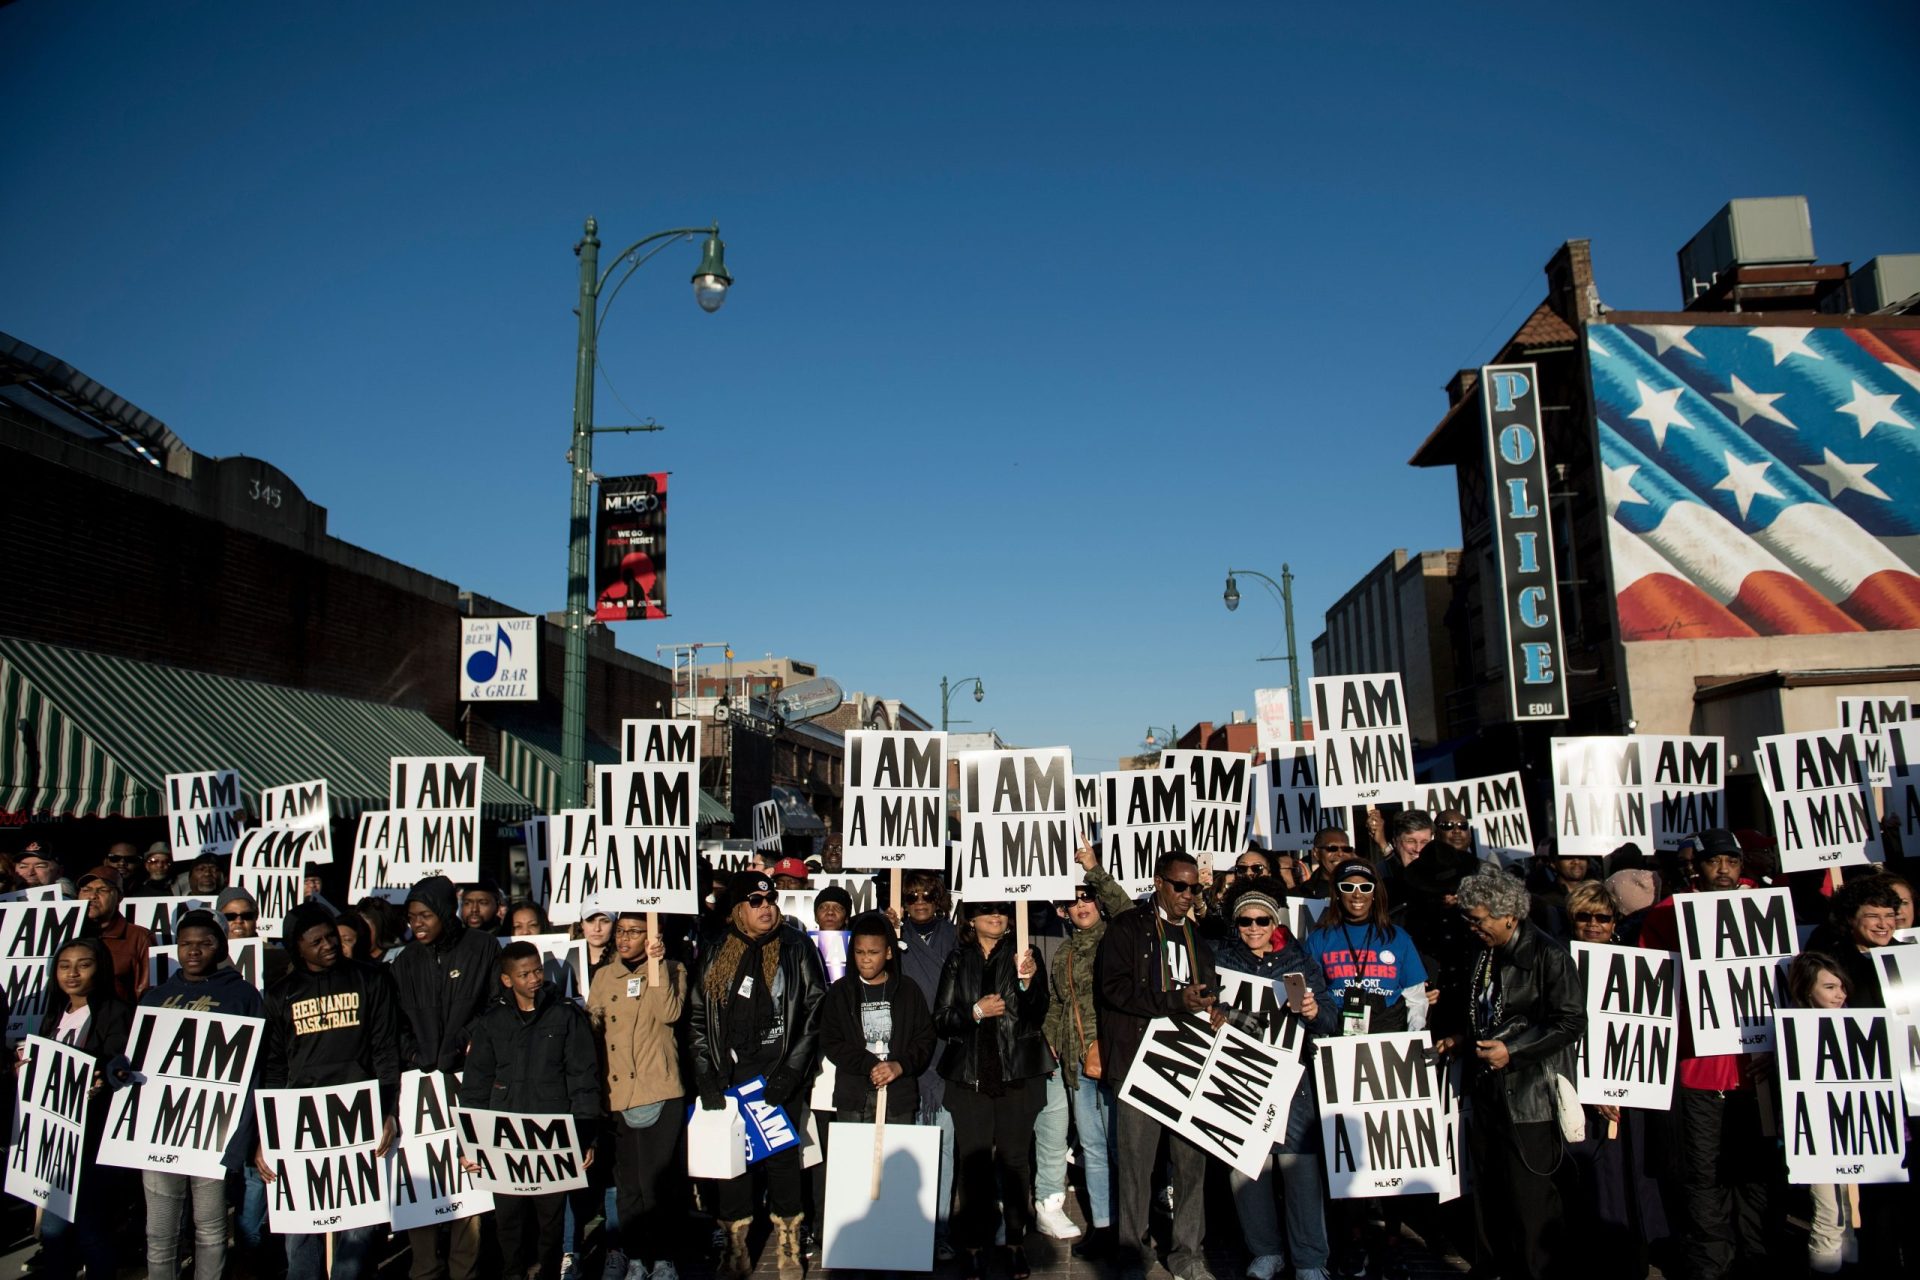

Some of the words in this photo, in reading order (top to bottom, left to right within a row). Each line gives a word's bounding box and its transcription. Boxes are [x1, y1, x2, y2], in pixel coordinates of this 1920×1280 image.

[605, 494, 659, 513] MLK50
[617, 530, 630, 538] WE
[630, 536, 654, 545] HERE?
[1492, 371, 1553, 684] POLICE
[465, 634, 493, 645] BLEW
[507, 620, 532, 631] NOTE
[471, 685, 481, 698] &
[486, 683, 527, 697] GRILL
[500, 668, 528, 682] BAR
[1315, 684, 1330, 731] I
[1341, 679, 1401, 730] AM
[1529, 703, 1552, 715] EDU
[1842, 701, 1849, 728] I
[627, 725, 635, 761] I
[645, 724, 695, 762] AM
[851, 737, 862, 787] I
[873, 737, 941, 788] AM
[1325, 739, 1342, 787] A
[1350, 734, 1408, 784] MAN
[1655, 741, 1718, 785] AM
[1766, 743, 1785, 792] I
[1796, 734, 1862, 789] AM
[1889, 728, 1909, 777] I
[396, 764, 407, 808] I
[417, 763, 477, 808] AM
[967, 757, 980, 812] I
[992, 756, 1066, 812] AM
[1271, 748, 1281, 787] I
[1291, 747, 1318, 787] A
[171, 779, 180, 810] I
[190, 774, 236, 809] AM
[266, 793, 272, 821] I
[602, 772, 612, 825] I
[625, 772, 690, 826] AM
[1107, 778, 1116, 826] I
[1128, 774, 1185, 825] AM
[1276, 794, 1290, 834] A
[1478, 777, 1520, 813] AM
[1662, 791, 1718, 834] MAN
[177, 816, 189, 847] A
[196, 811, 240, 844] MAN
[360, 817, 371, 848] I
[563, 815, 573, 855] I
[759, 804, 778, 839] AM
[849, 796, 867, 847] A
[880, 796, 939, 847] MAN
[1485, 813, 1527, 849] MAN
[1564, 793, 1579, 836] A
[1784, 800, 1803, 850] A
[1807, 791, 1875, 847] MAN
[236, 831, 257, 867] I
[252, 831, 312, 868] AM
[394, 817, 410, 863] A
[421, 816, 474, 863] MAN
[537, 821, 547, 860] I
[969, 822, 989, 878] A
[1002, 820, 1068, 877] MAN
[1109, 834, 1123, 880] A
[354, 855, 367, 889] A
[556, 863, 571, 903] A
[604, 835, 622, 889] A
[633, 835, 690, 890] MAN
[1682, 901, 1701, 961] I
[1716, 895, 1792, 959] AM
[292, 992, 360, 1020] HERNANDO
[1601, 954, 1674, 1018] AM
[1698, 970, 1720, 1030] A
[131, 1014, 157, 1071] I
[158, 1017, 255, 1083] AM
[1143, 1014, 1216, 1099] AM
[1603, 1021, 1671, 1085] MAN
[1782, 1017, 1801, 1081] I
[1816, 1017, 1892, 1080] AM
[22, 1044, 39, 1102] I
[40, 1050, 90, 1124] AM
[739, 1080, 764, 1097] I
[1203, 1034, 1278, 1126] MAN
[1320, 1046, 1338, 1104] I
[1353, 1038, 1430, 1102] AM
[111, 1082, 142, 1141] A
[151, 1085, 237, 1152] MAN
[263, 1097, 280, 1150] I
[298, 1088, 375, 1147] AM
[1128, 1084, 1182, 1124] I
[1794, 1091, 1816, 1156] A
[1827, 1090, 1900, 1156] MAN
[13, 1112, 31, 1172] A
[35, 1119, 79, 1195] MAN
[458, 1113, 478, 1144] I
[493, 1116, 571, 1150] AM
[1190, 1115, 1245, 1159] A
[1335, 1113, 1356, 1174] A
[1364, 1107, 1440, 1171] MAN
[276, 1159, 295, 1211] A
[305, 1150, 380, 1211] MAN
[396, 1148, 417, 1206] A
[476, 1149, 496, 1181] A
[505, 1152, 578, 1184] MAN
